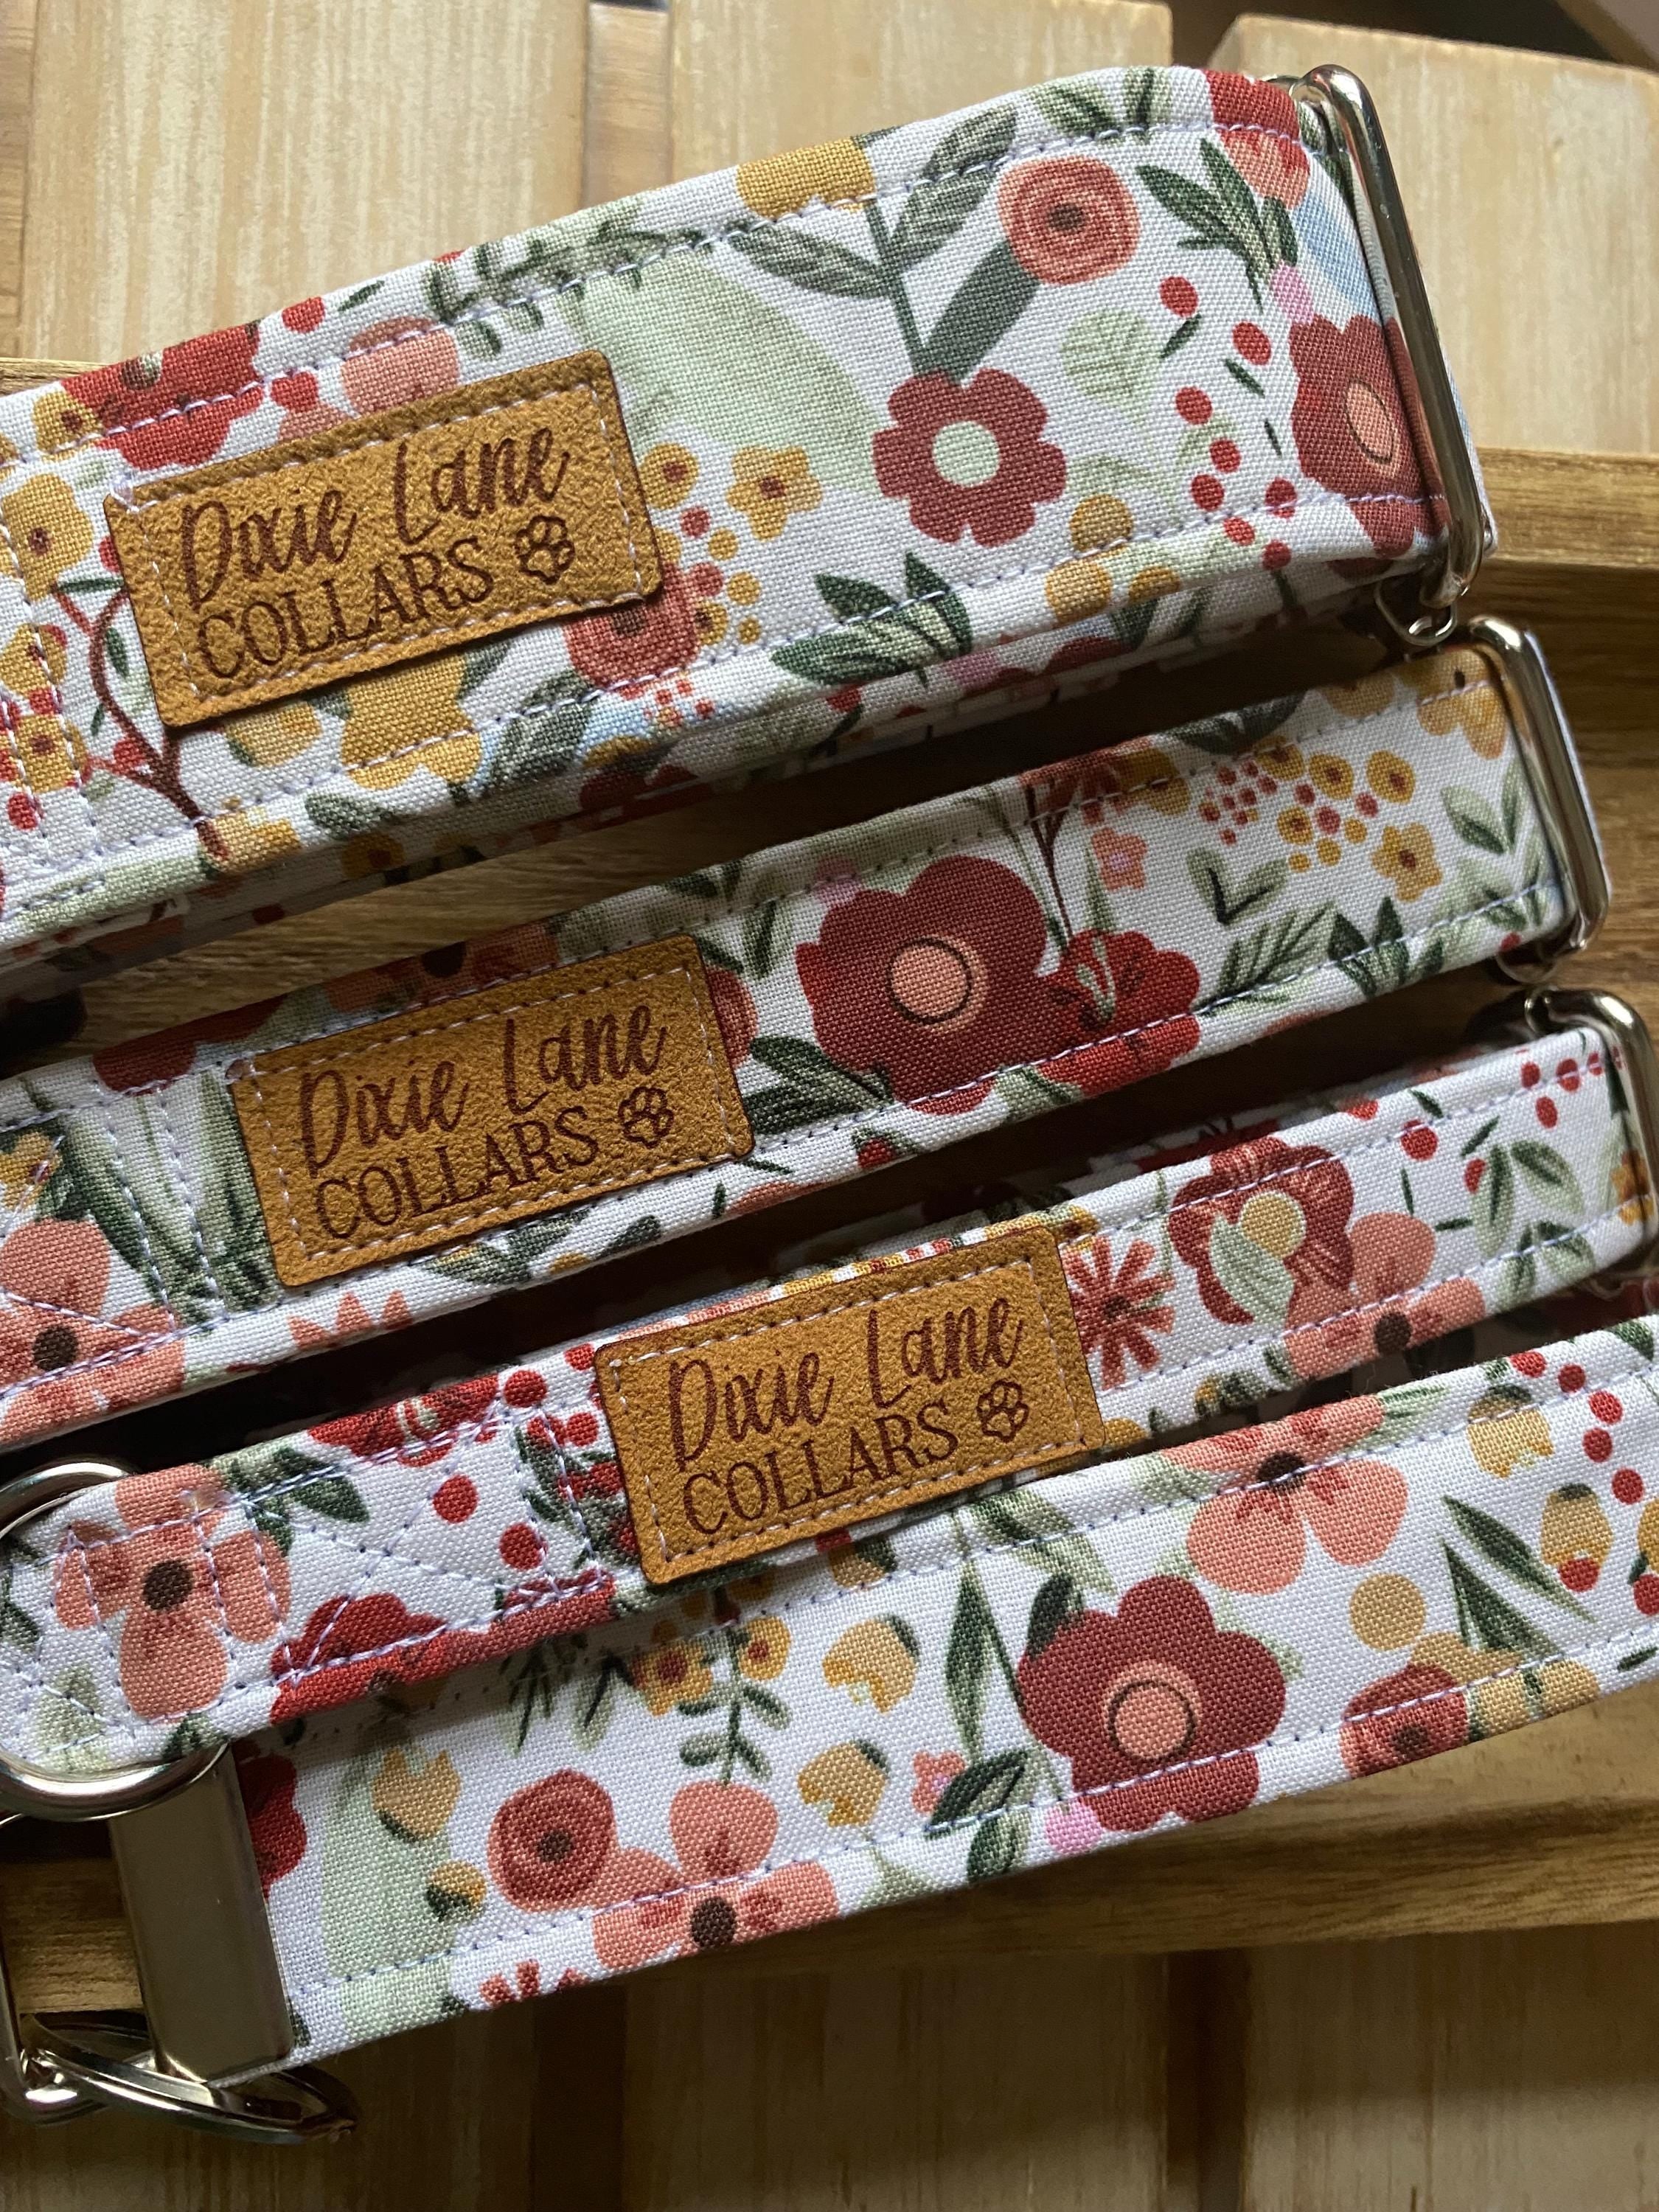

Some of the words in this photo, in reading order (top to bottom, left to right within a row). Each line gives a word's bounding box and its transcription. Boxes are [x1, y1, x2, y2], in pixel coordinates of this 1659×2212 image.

[180, 488, 358, 611] Dixie
[392, 428, 571, 545] Lane
[198, 535, 494, 679] COLLARS
[299, 1060, 469, 1179] Dixie
[501, 1005, 667, 1115] Lane
[314, 1105, 599, 1239] COLLARS
[668, 1350, 835, 1473] Dixie
[866, 1297, 1025, 1408] Lane
[684, 1400, 959, 1535] COLLARS
